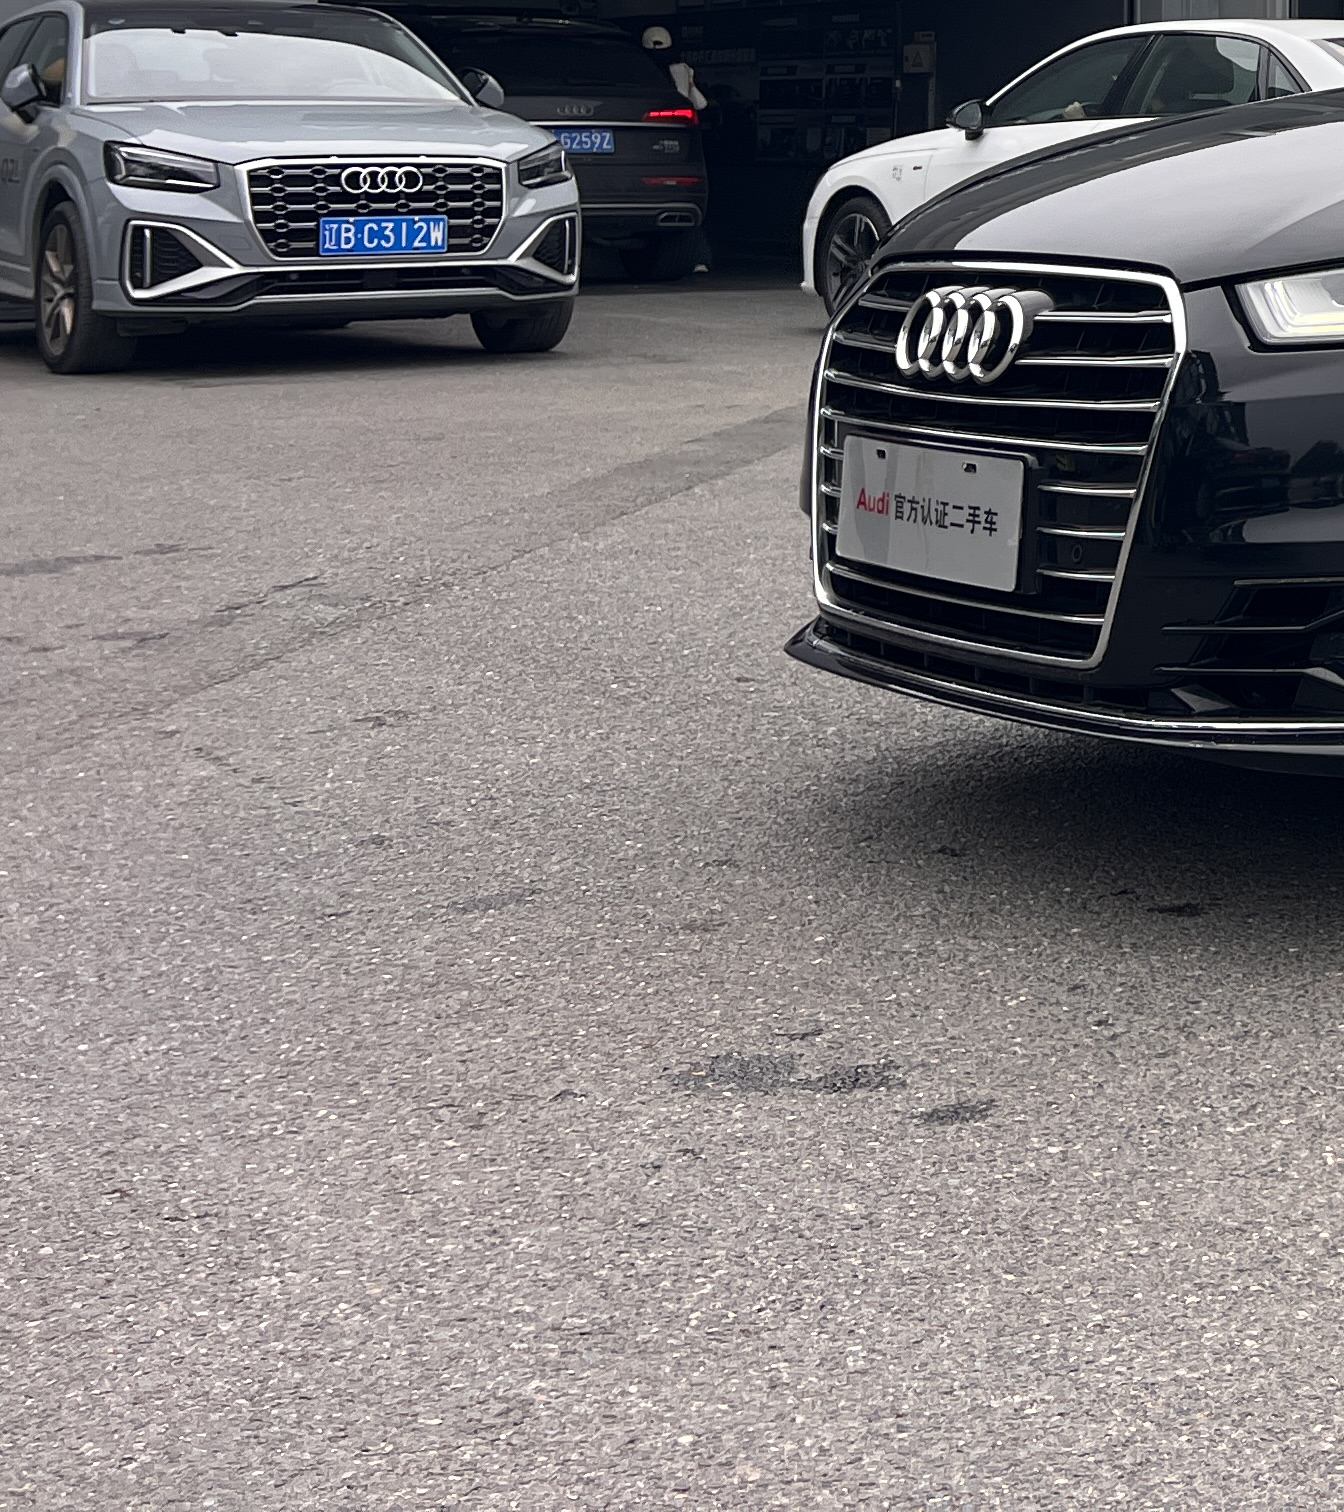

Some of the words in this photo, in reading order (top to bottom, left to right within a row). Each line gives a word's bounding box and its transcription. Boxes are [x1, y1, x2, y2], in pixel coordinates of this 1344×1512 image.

[323, 220, 445, 250] 辽B·C312W
[855, 487, 891, 516] Audi
[893, 492, 999, 537] 官方认证二手车
